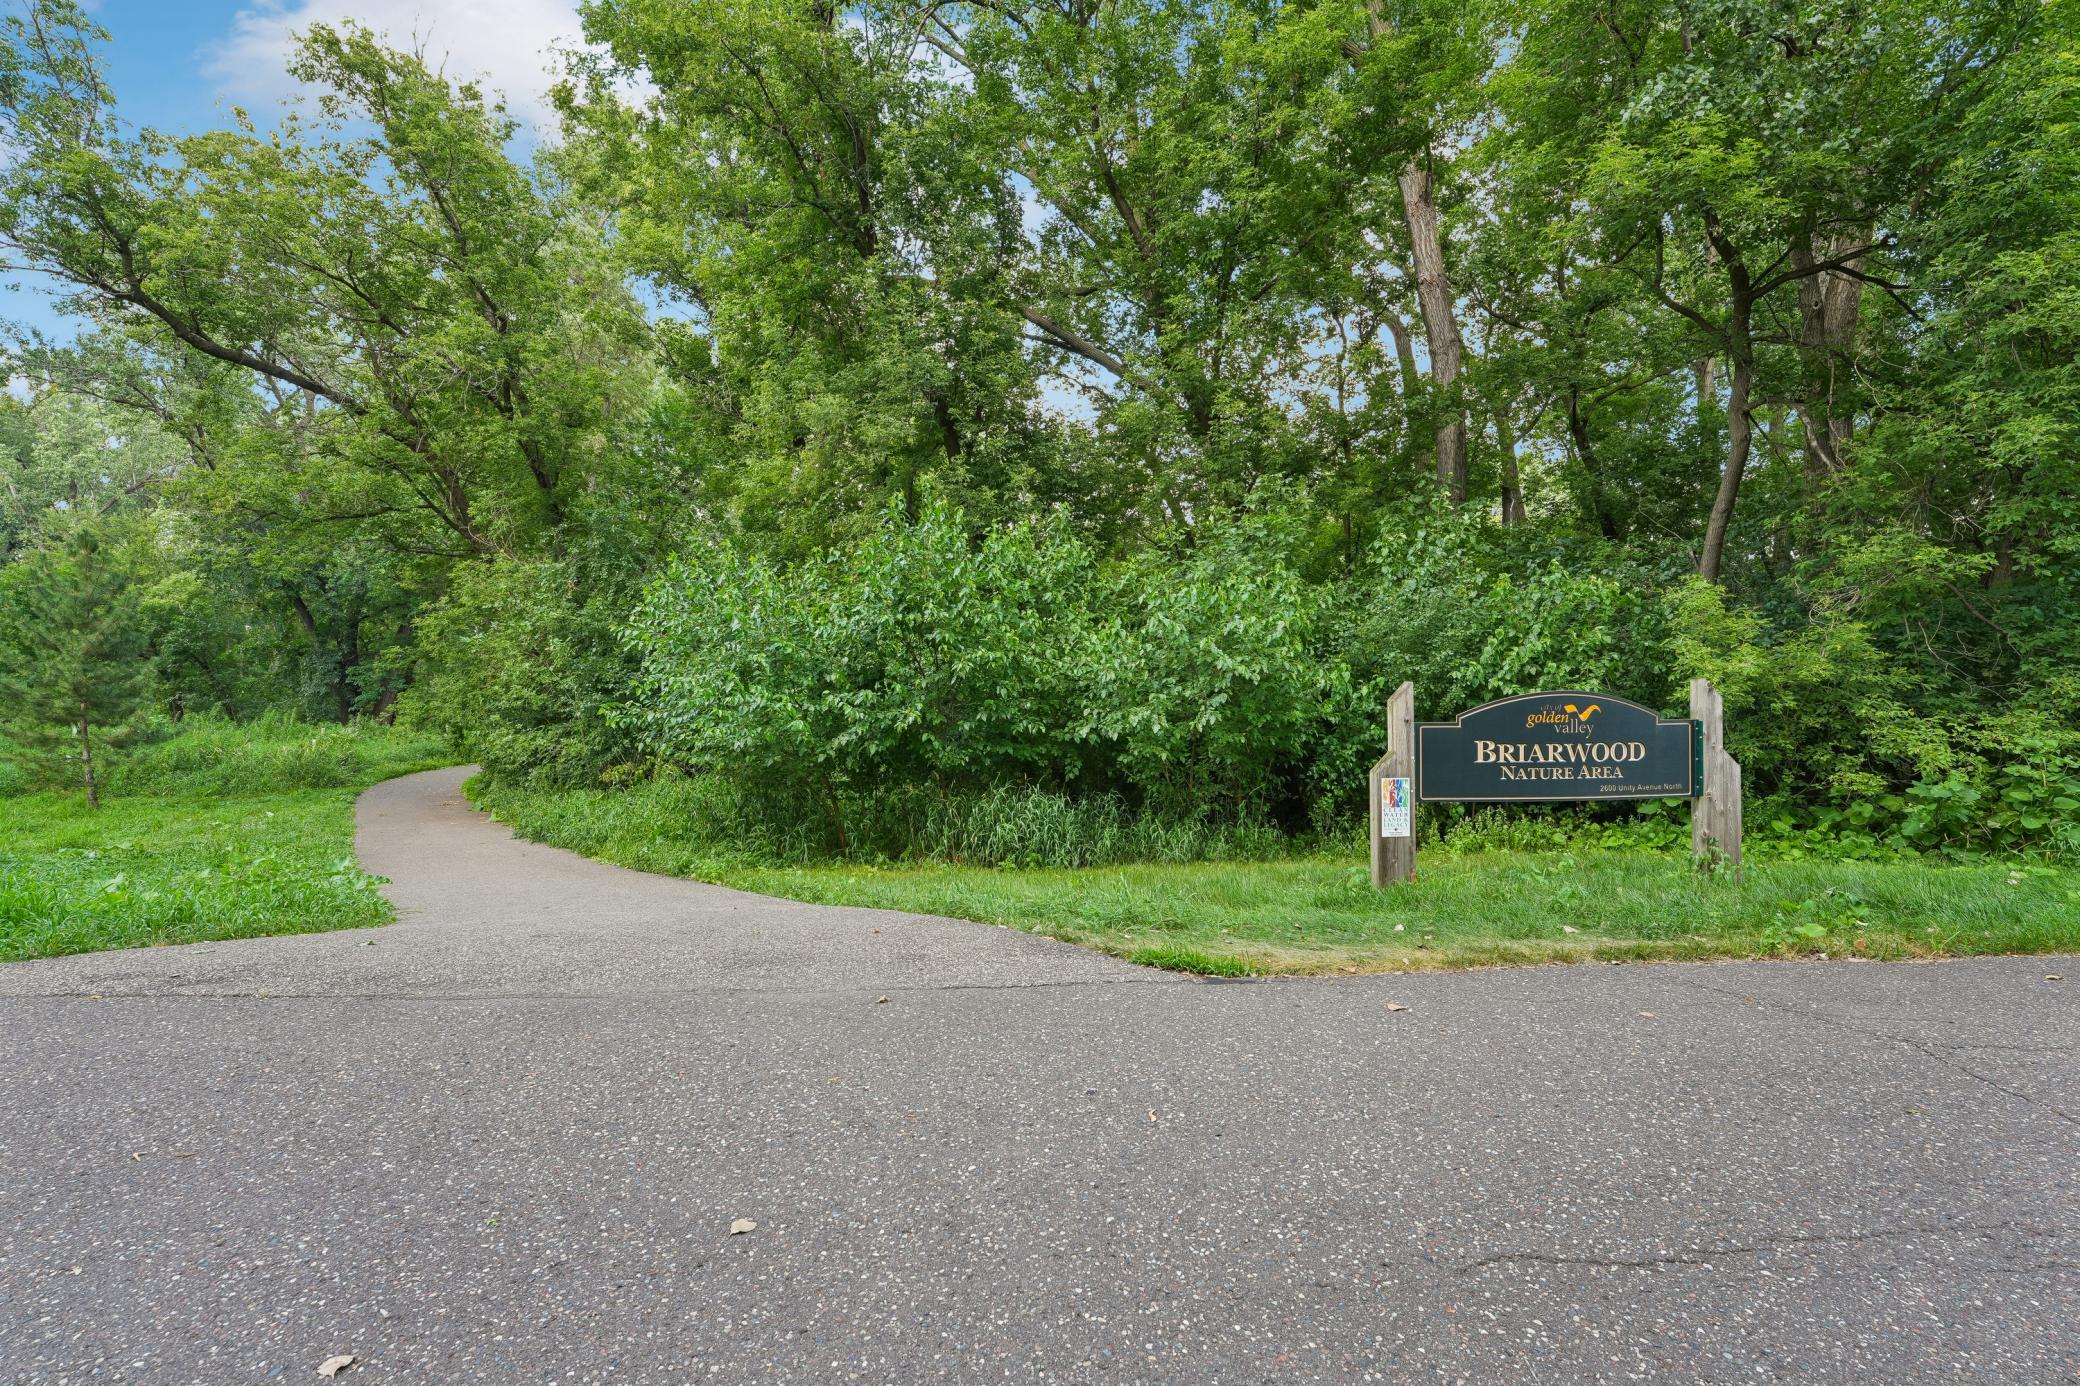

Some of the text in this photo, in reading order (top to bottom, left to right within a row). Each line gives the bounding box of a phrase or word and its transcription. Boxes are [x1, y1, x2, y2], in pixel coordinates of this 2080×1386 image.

[1526, 710, 1569, 728] golden
[1554, 718, 1594, 738] valley
[1474, 740, 1646, 763] BRIARWOOD
[1500, 764, 1624, 780] NATURE AREA
[1618, 784, 1636, 793] Unity
[1637, 783, 1661, 791] Avenue
